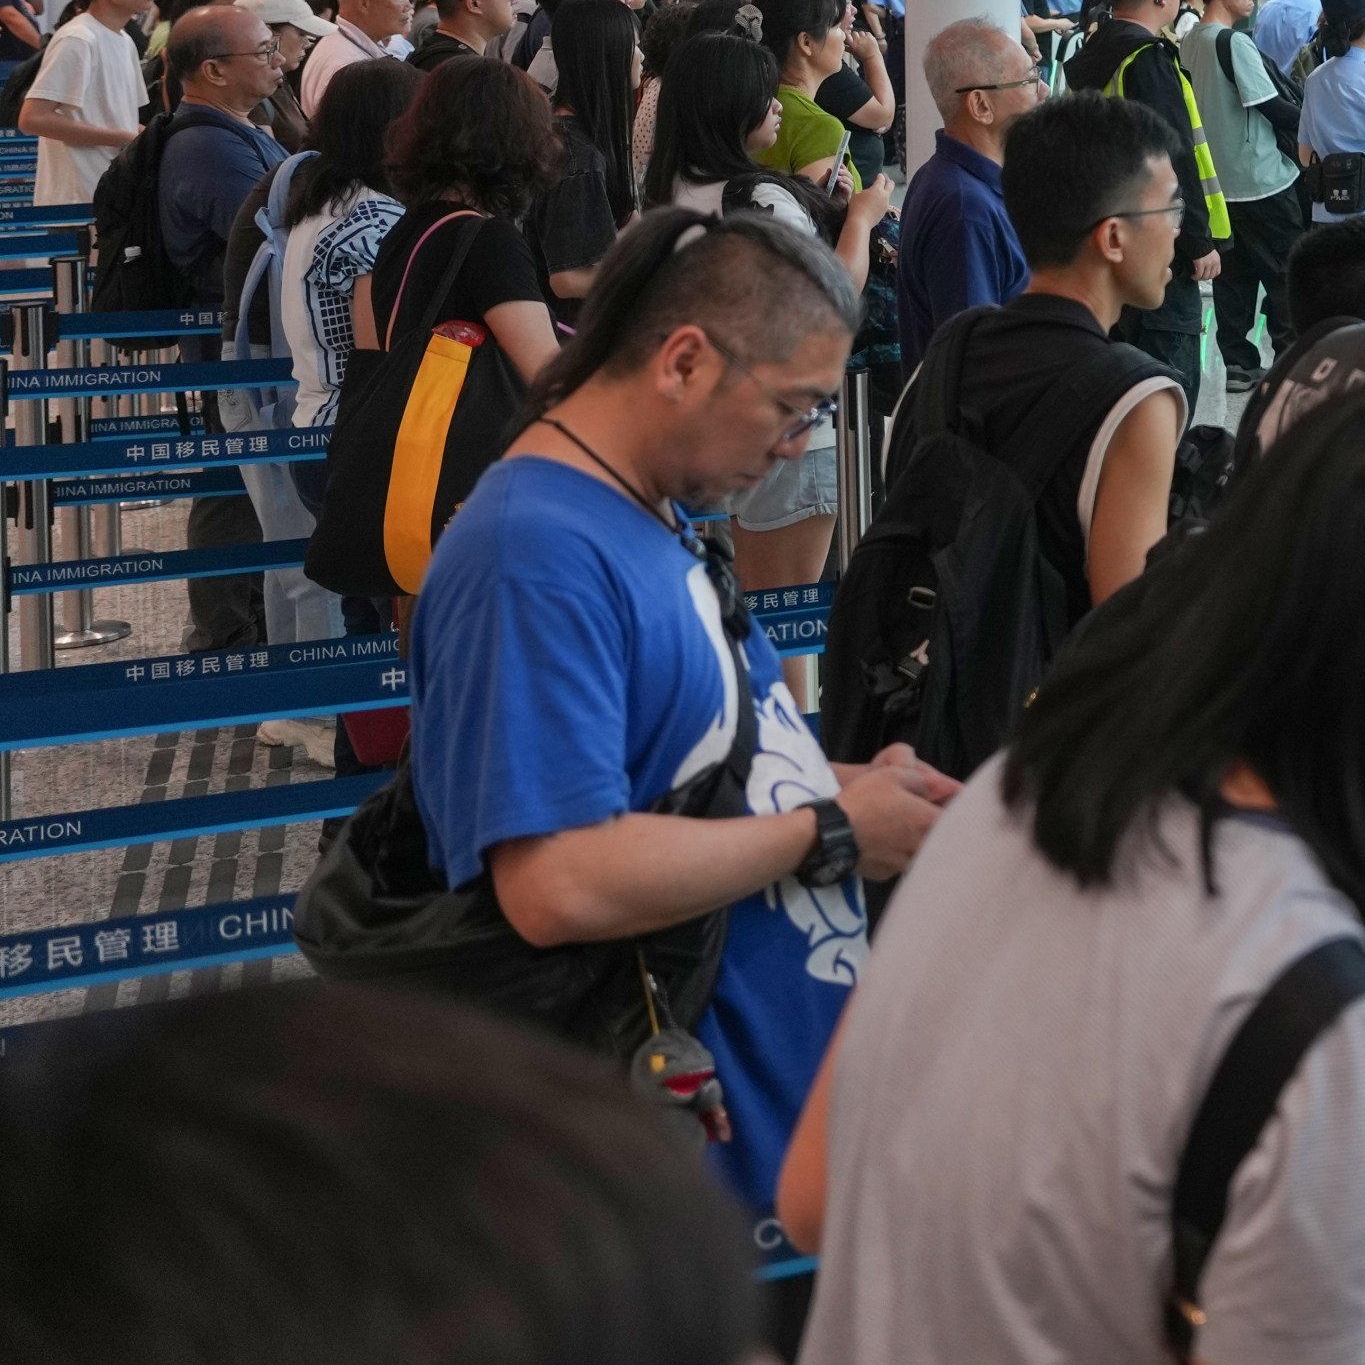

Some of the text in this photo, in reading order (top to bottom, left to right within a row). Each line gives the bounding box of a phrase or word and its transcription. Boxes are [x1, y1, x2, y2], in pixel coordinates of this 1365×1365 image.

[46, 370, 161, 387] IMMIGRATION
[126, 436, 269, 462] 中国移民管理
[90, 478, 191, 495] IMMIGRATION
[47, 558, 163, 580] IMMIGRATION
[126, 652, 270, 682] 中国移民管理
[289, 644, 347, 663] CHINA
